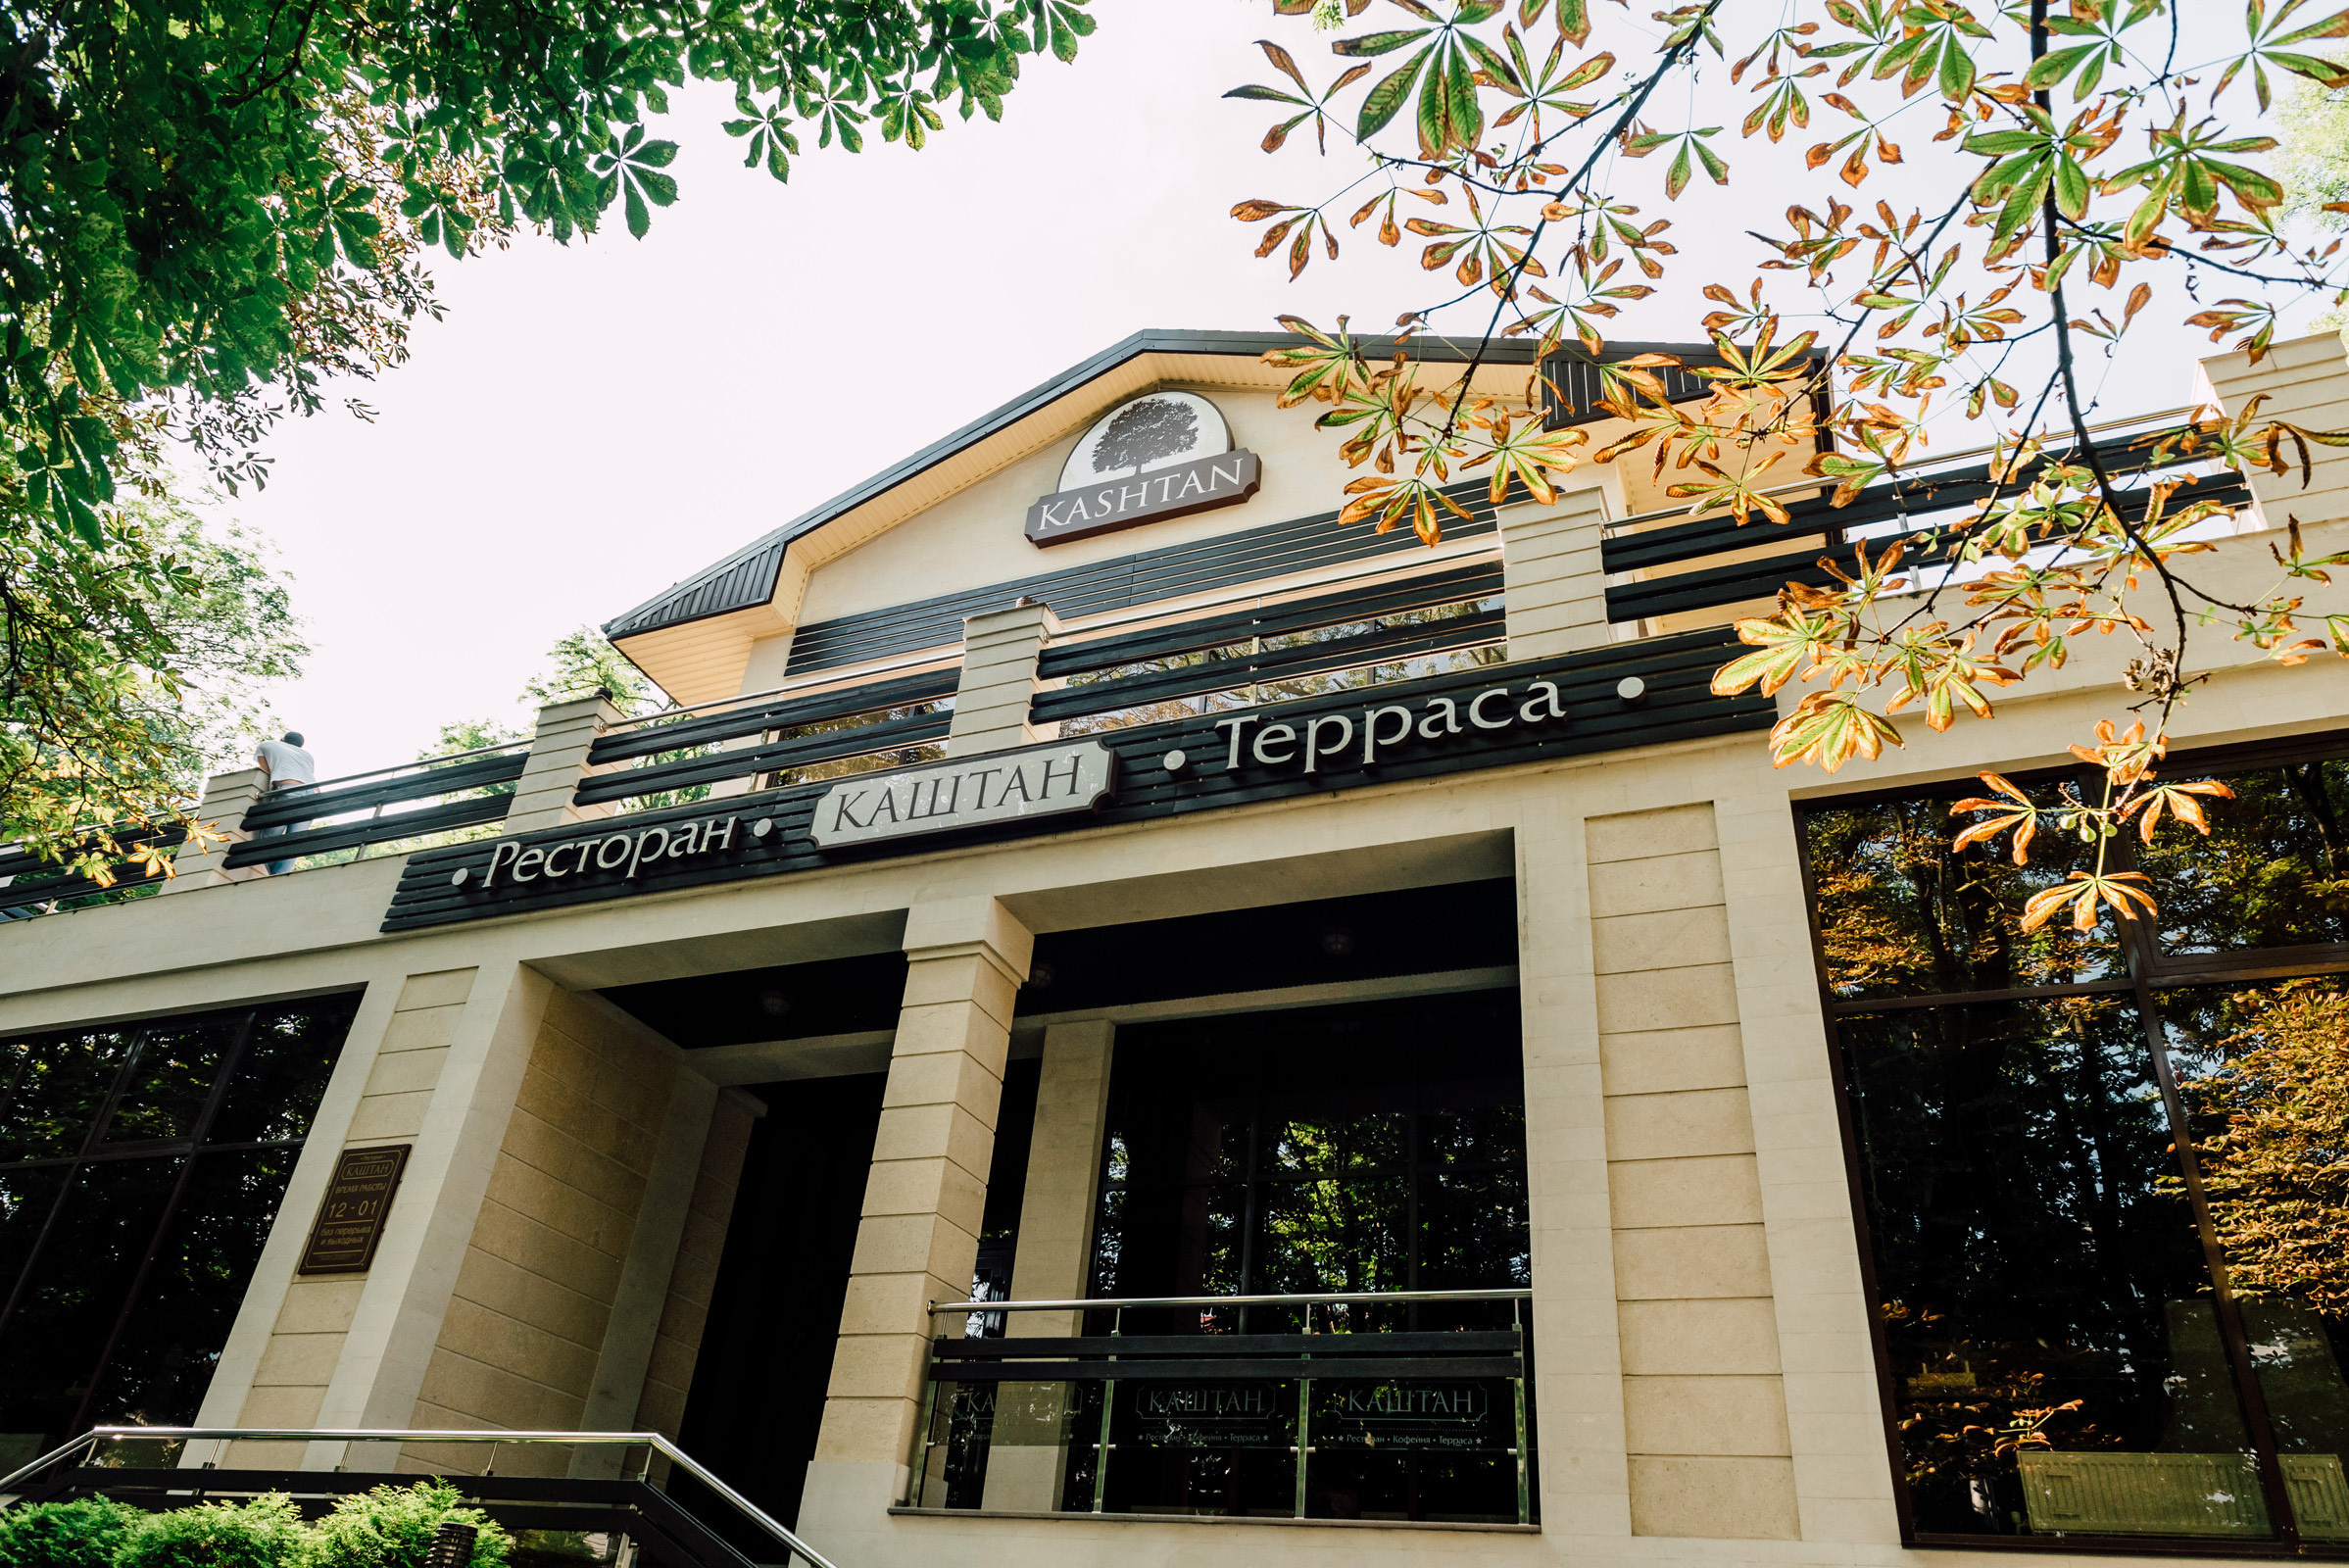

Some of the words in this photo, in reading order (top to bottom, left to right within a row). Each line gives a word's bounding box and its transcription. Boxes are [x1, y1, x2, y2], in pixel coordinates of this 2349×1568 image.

[1038, 458, 1244, 531] KASHTAN
[482, 815, 741, 889] Ресторан
[831, 754, 1084, 833] КАШТАН
[1214, 680, 1567, 774] Терраса
[346, 1163, 390, 1176] КАШТАН
[335, 1185, 358, 1194] ВРЕМЯ
[359, 1182, 387, 1192] РАБОТЫ
[1149, 1390, 1262, 1413] КАШТАН
[1348, 1390, 1472, 1413] КАШТАН
[1393, 1434, 1431, 1446] Кофейня
[1439, 1436, 1473, 1446] Терраса
